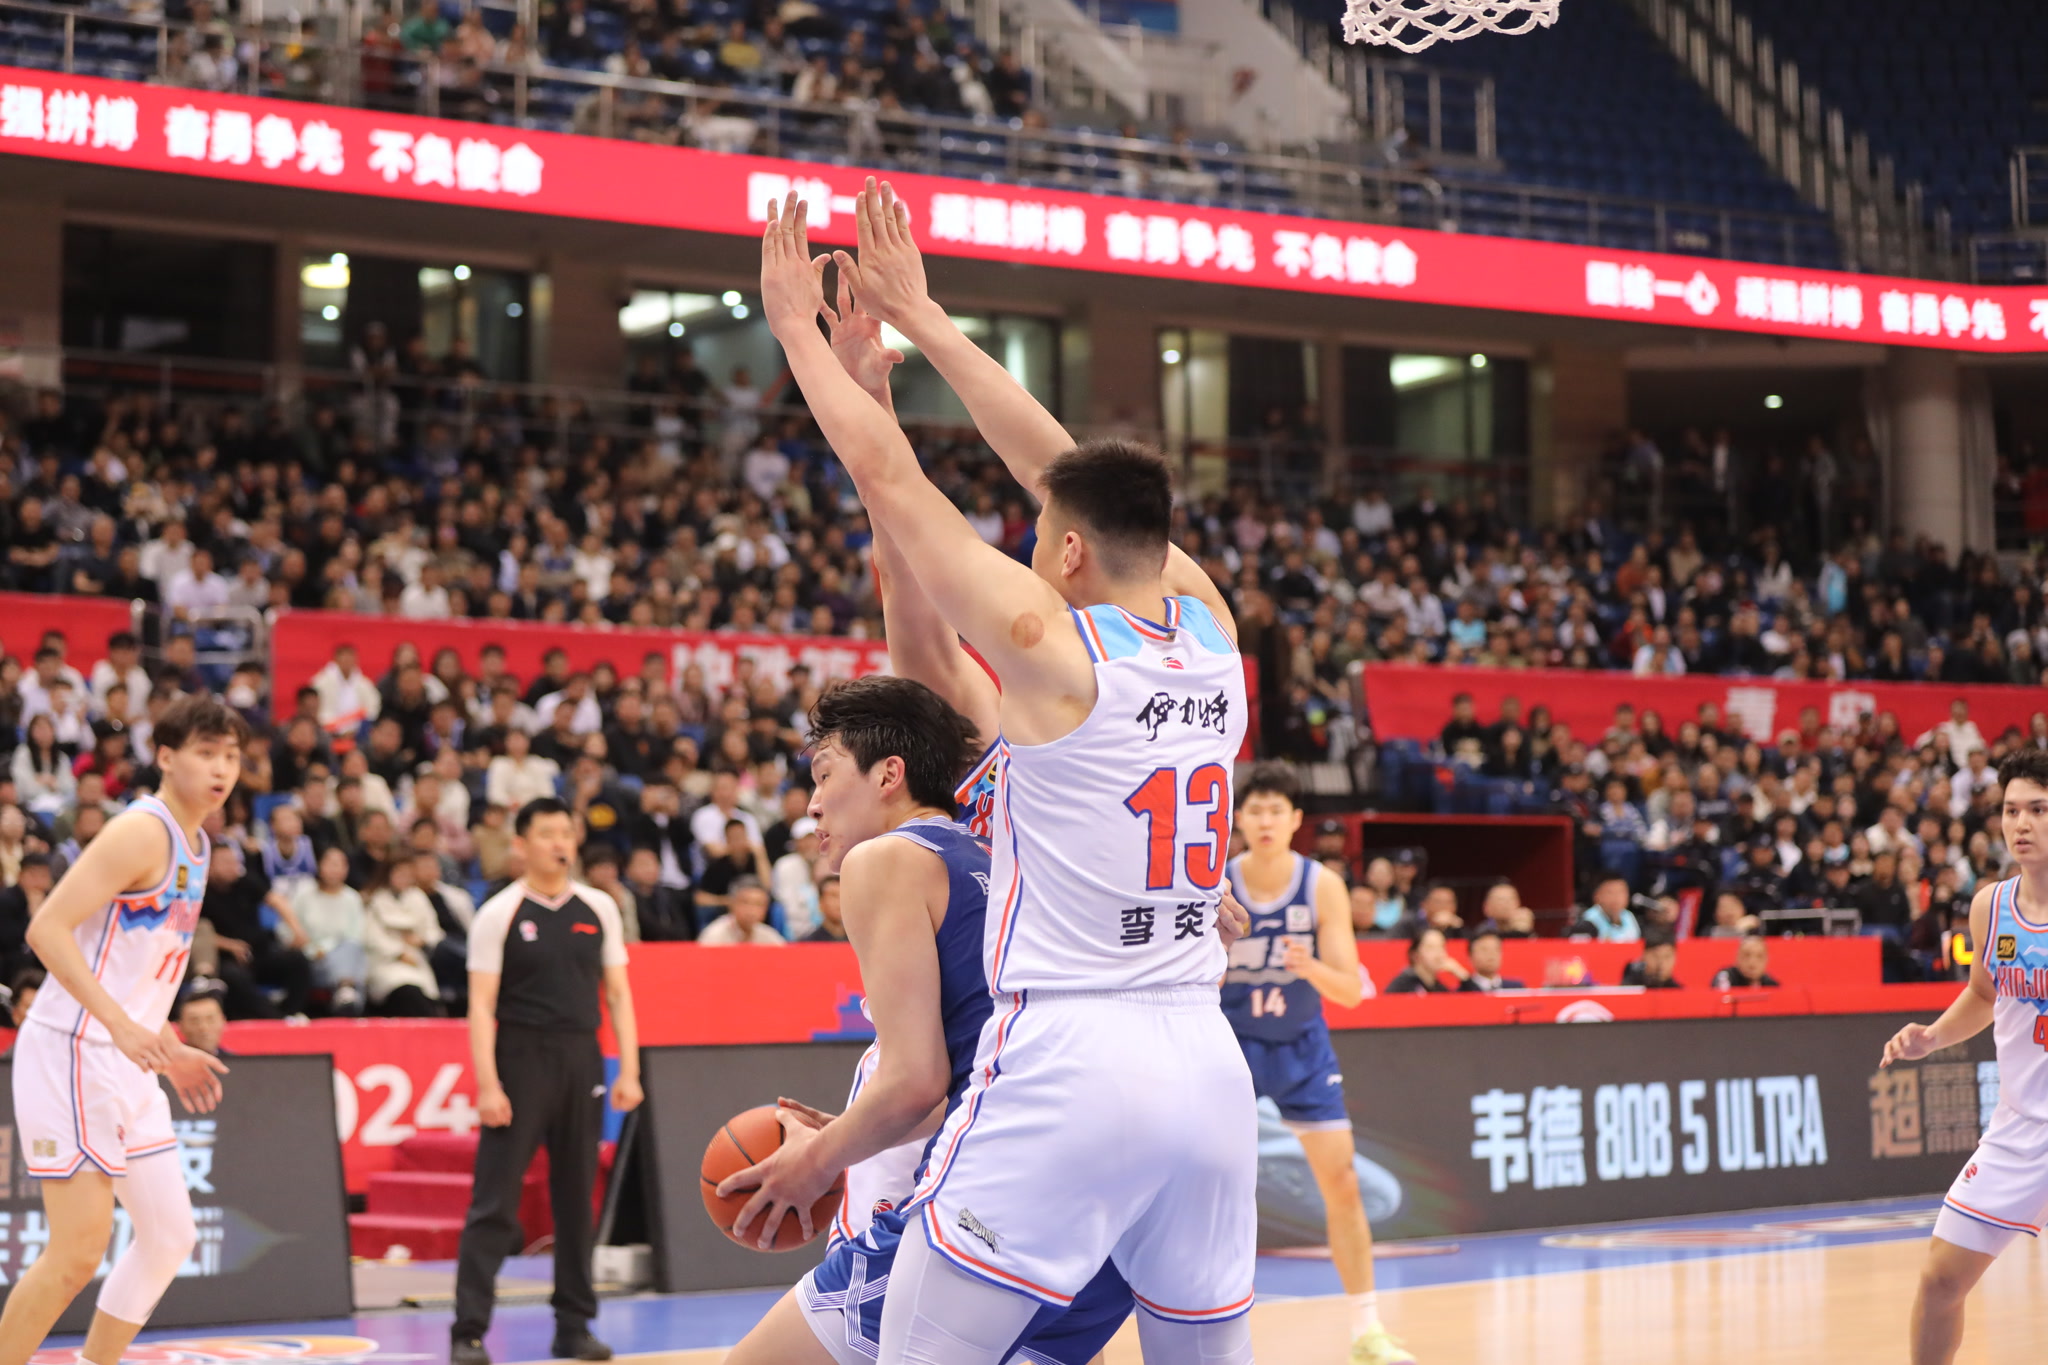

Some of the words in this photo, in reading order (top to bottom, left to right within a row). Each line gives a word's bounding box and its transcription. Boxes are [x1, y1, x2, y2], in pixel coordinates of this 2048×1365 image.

[747, 171, 912, 229] 团结一
[1585, 260, 1720, 316] 团结一心
[1123, 763, 1231, 891] 13
[155, 948, 189, 985] 11
[1251, 987, 1287, 1017] 14
[1471, 1085, 1586, 1193] 韦德
[1595, 1082, 1673, 1181] 808
[1679, 1079, 1709, 1174] 5
[1716, 1074, 1828, 1172] ULTRA
